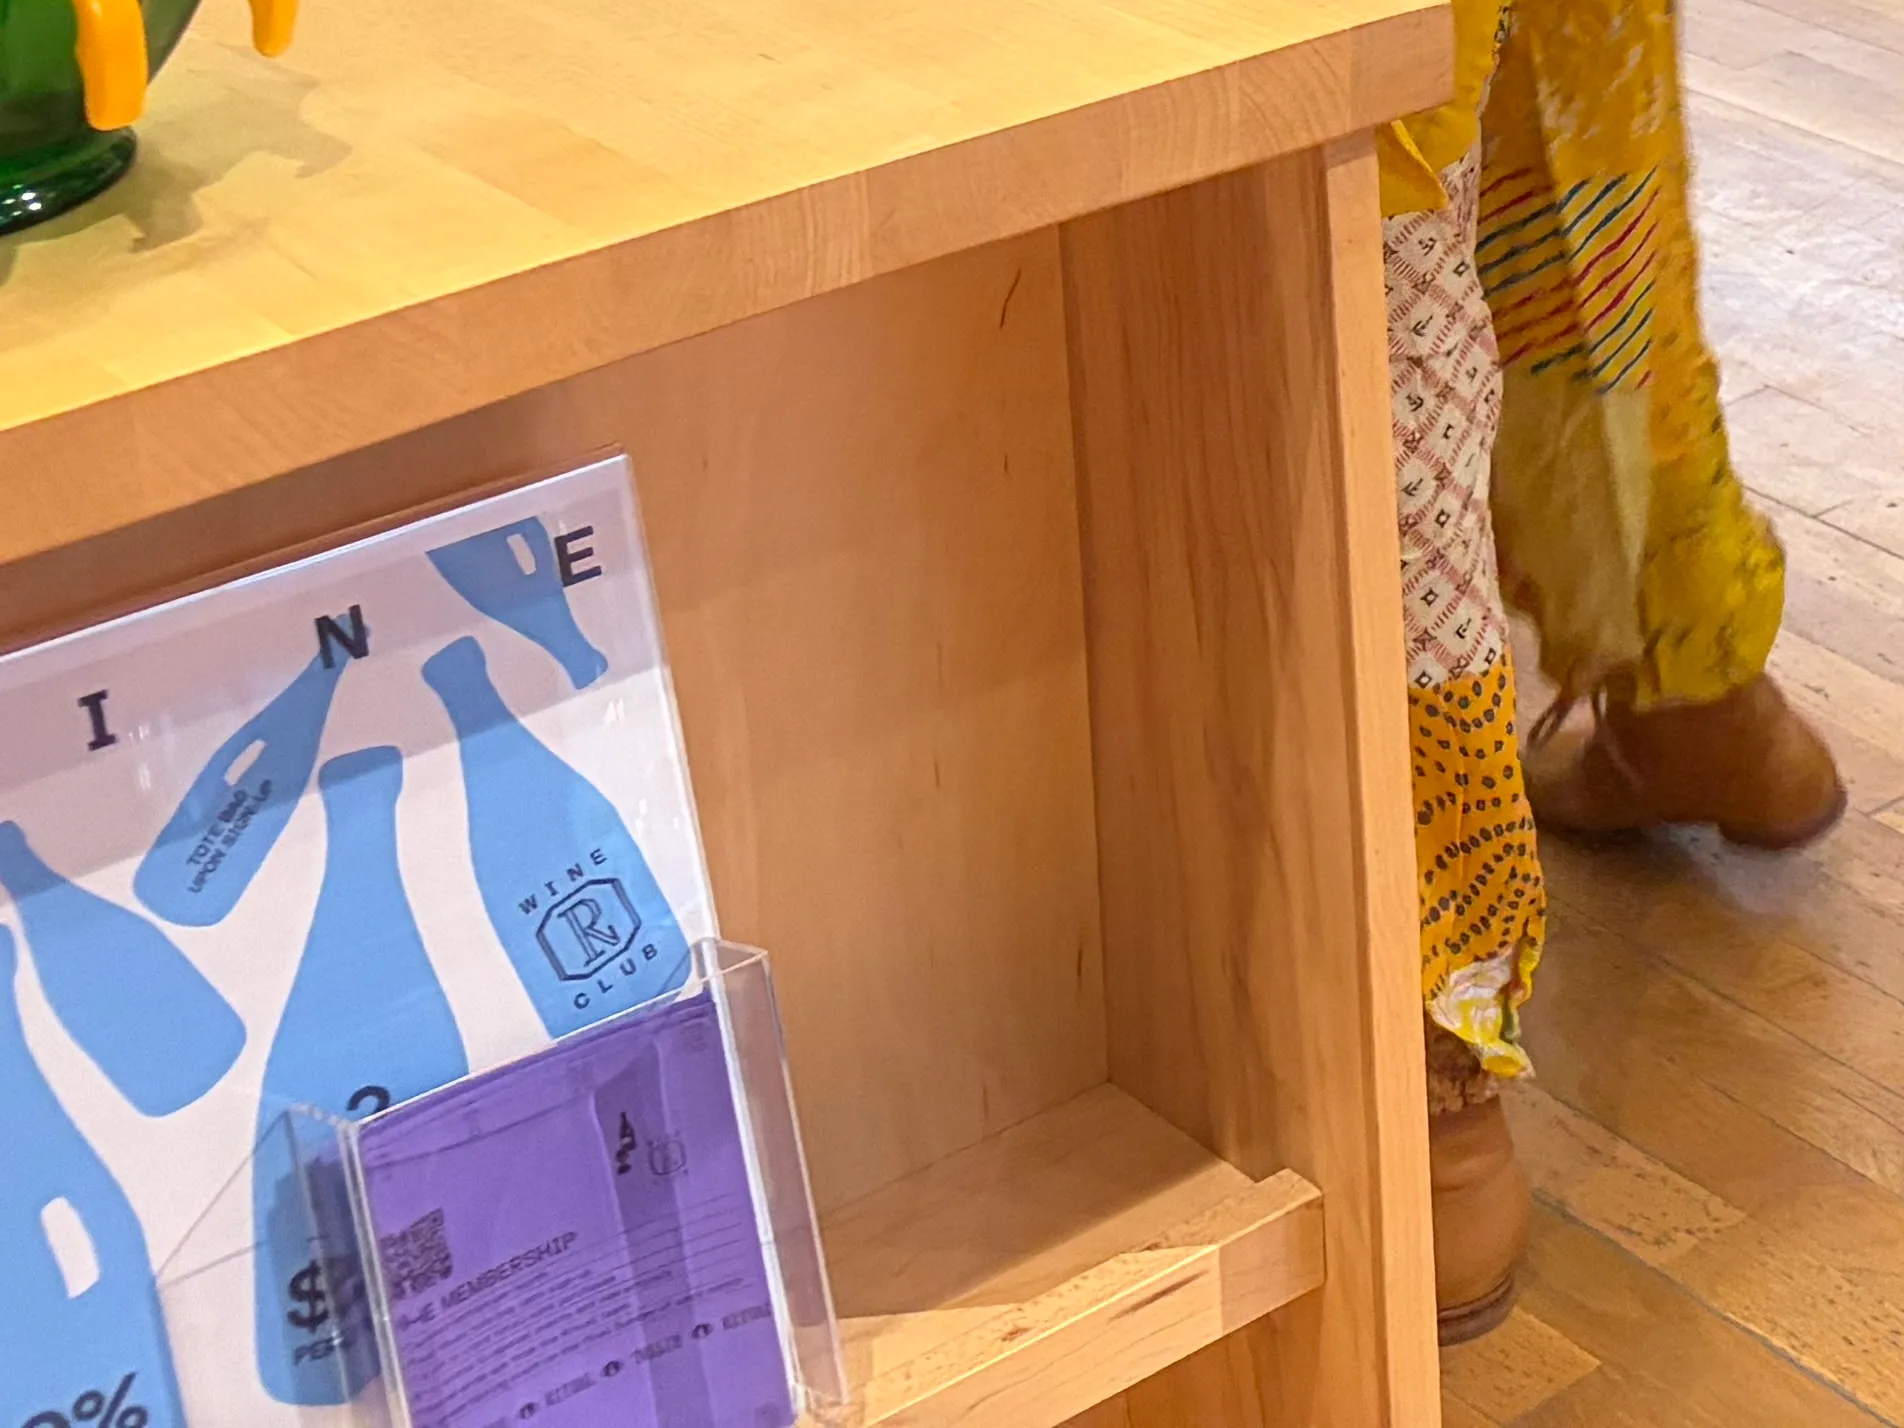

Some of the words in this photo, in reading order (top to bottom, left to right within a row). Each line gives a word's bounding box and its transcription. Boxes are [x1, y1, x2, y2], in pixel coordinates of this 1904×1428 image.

[518, 847, 609, 915] WINE
[573, 941, 658, 1012] CLUB
[440, 1230, 578, 1310] MEMBERSHIP
